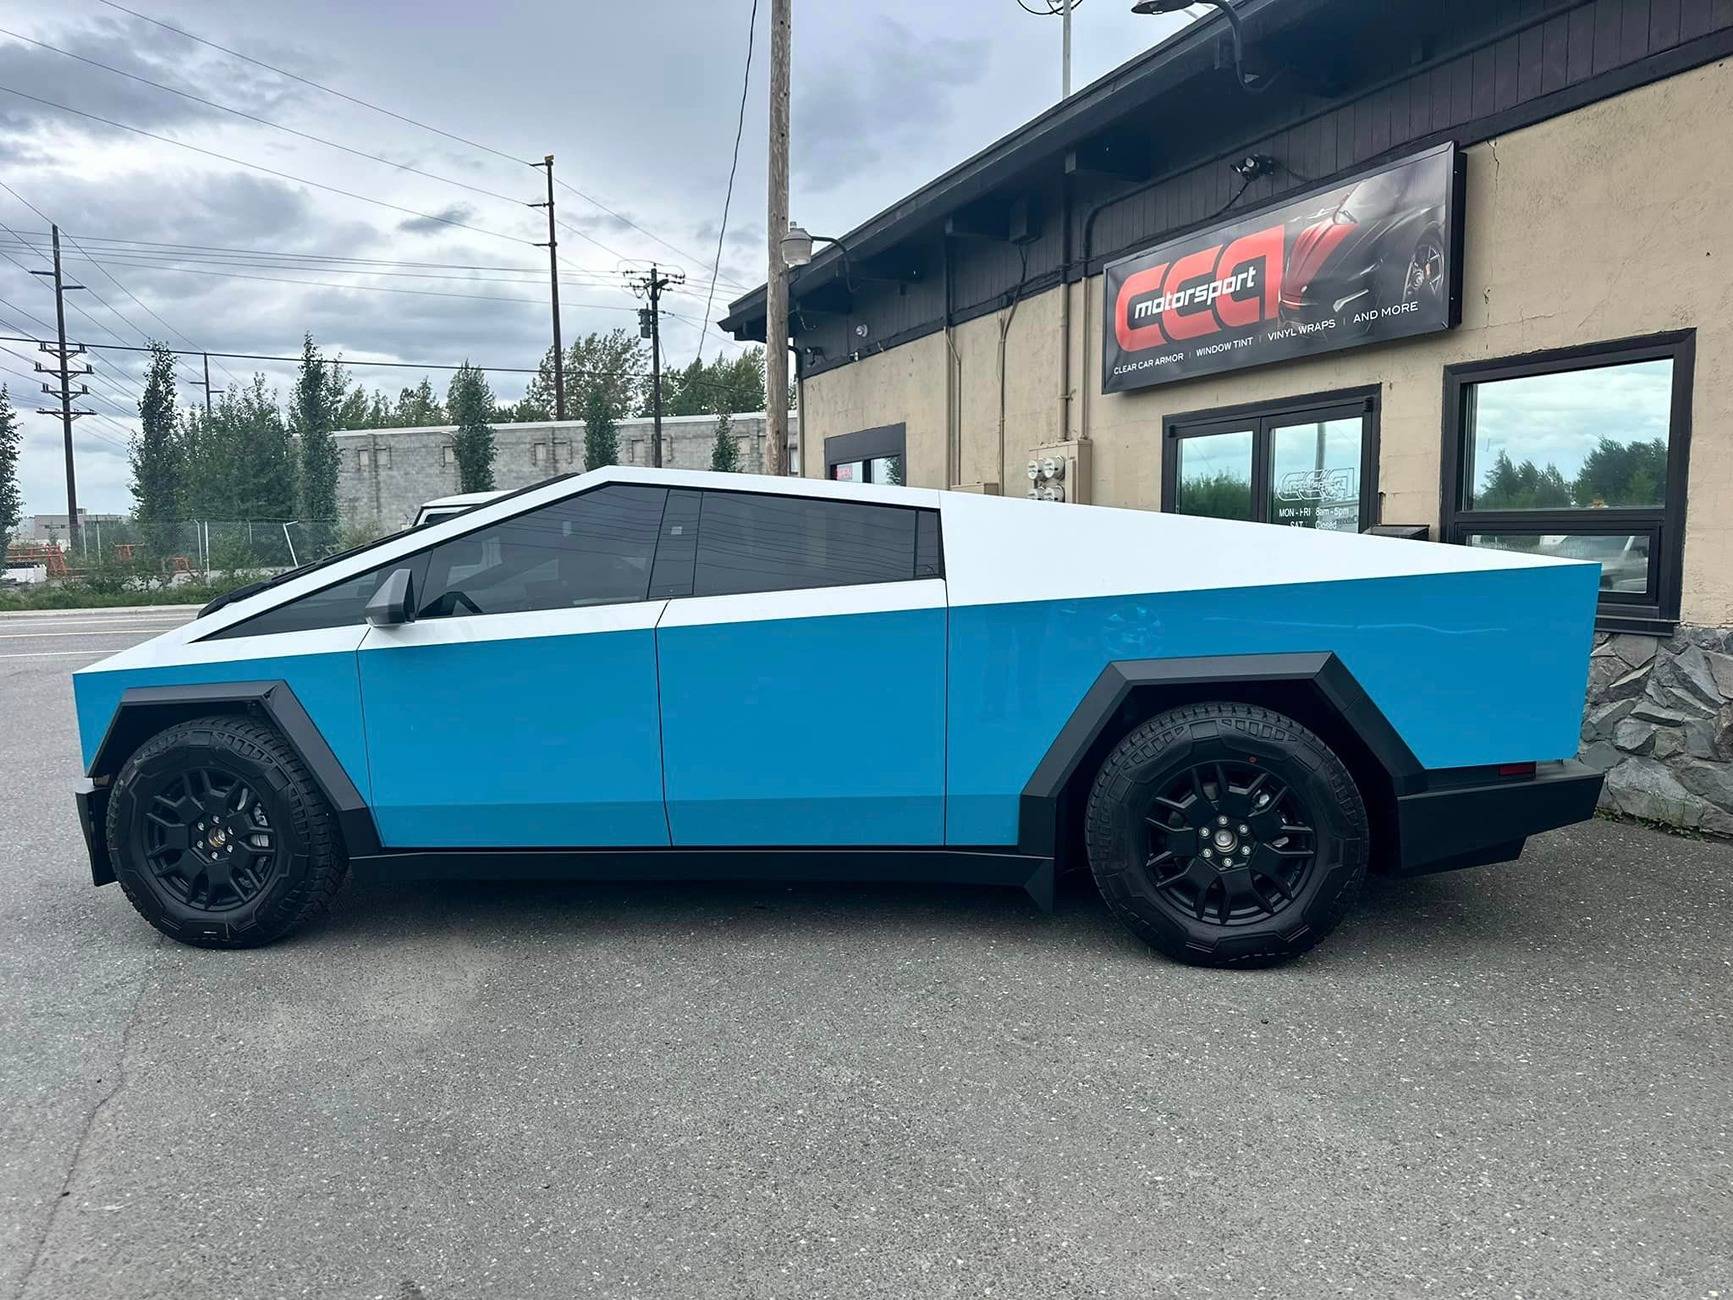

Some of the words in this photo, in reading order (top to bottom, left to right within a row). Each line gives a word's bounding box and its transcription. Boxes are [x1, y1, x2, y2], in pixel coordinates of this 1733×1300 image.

[1134, 266, 1257, 319] motorsport
[1113, 363, 1137, 375] CLEAR
[1137, 359, 1154, 370] CAR
[1154, 352, 1184, 366] ARMOR
[1195, 341, 1232, 357] WINDOW
[1233, 336, 1254, 349] TINT
[1267, 327, 1298, 341] VINYL
[1298, 319, 1336, 335] WRAPS
[1353, 310, 1379, 323] AND
[1381, 301, 1419, 317] MORE
[1278, 508, 1295, 517] MON
[1299, 507, 1311, 517] FRI
[1315, 507, 1330, 516] 8am
